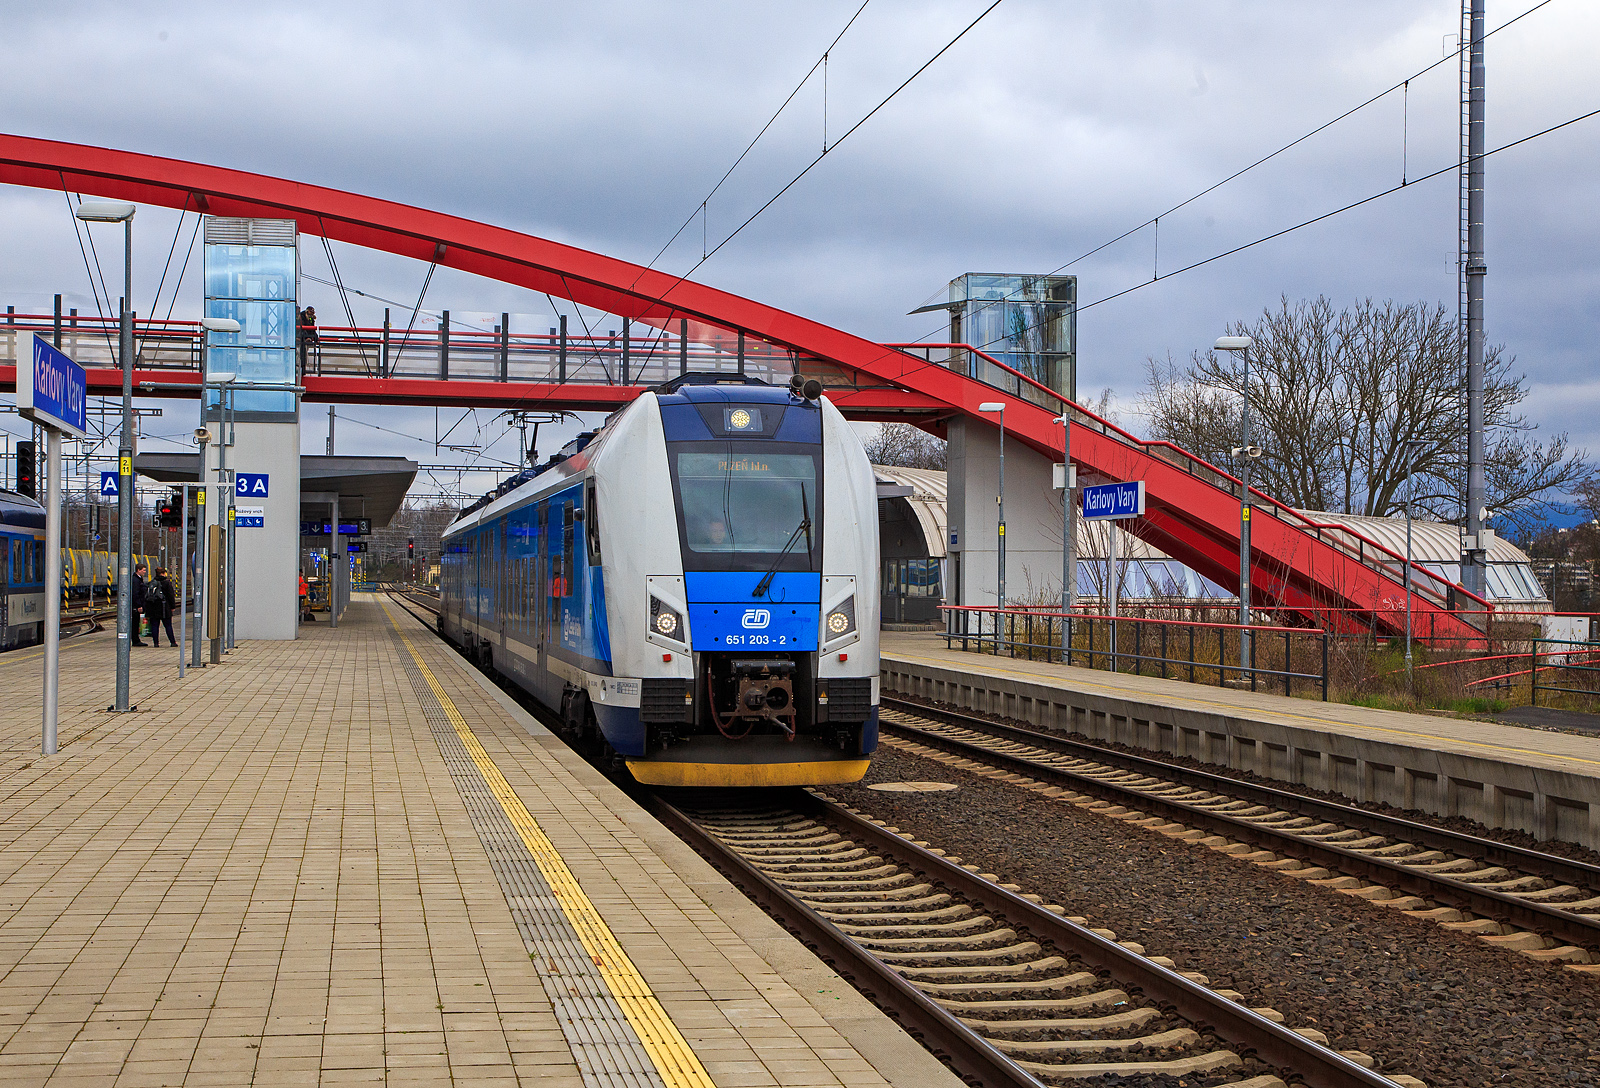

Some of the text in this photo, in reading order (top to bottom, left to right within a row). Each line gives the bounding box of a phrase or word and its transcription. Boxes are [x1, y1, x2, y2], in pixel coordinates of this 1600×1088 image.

[35, 343, 83, 426] Karlovy Vary
[718, 458, 748, 471] PLZEŇ
[102, 476, 118, 492] A
[237, 477, 267, 493] 3 A
[1086, 486, 1136, 514] Karlovy Vary
[154, 515, 160, 528] 5
[725, 634, 745, 645] 651
[749, 634, 769, 645] 203
[779, 635, 786, 645] 2
